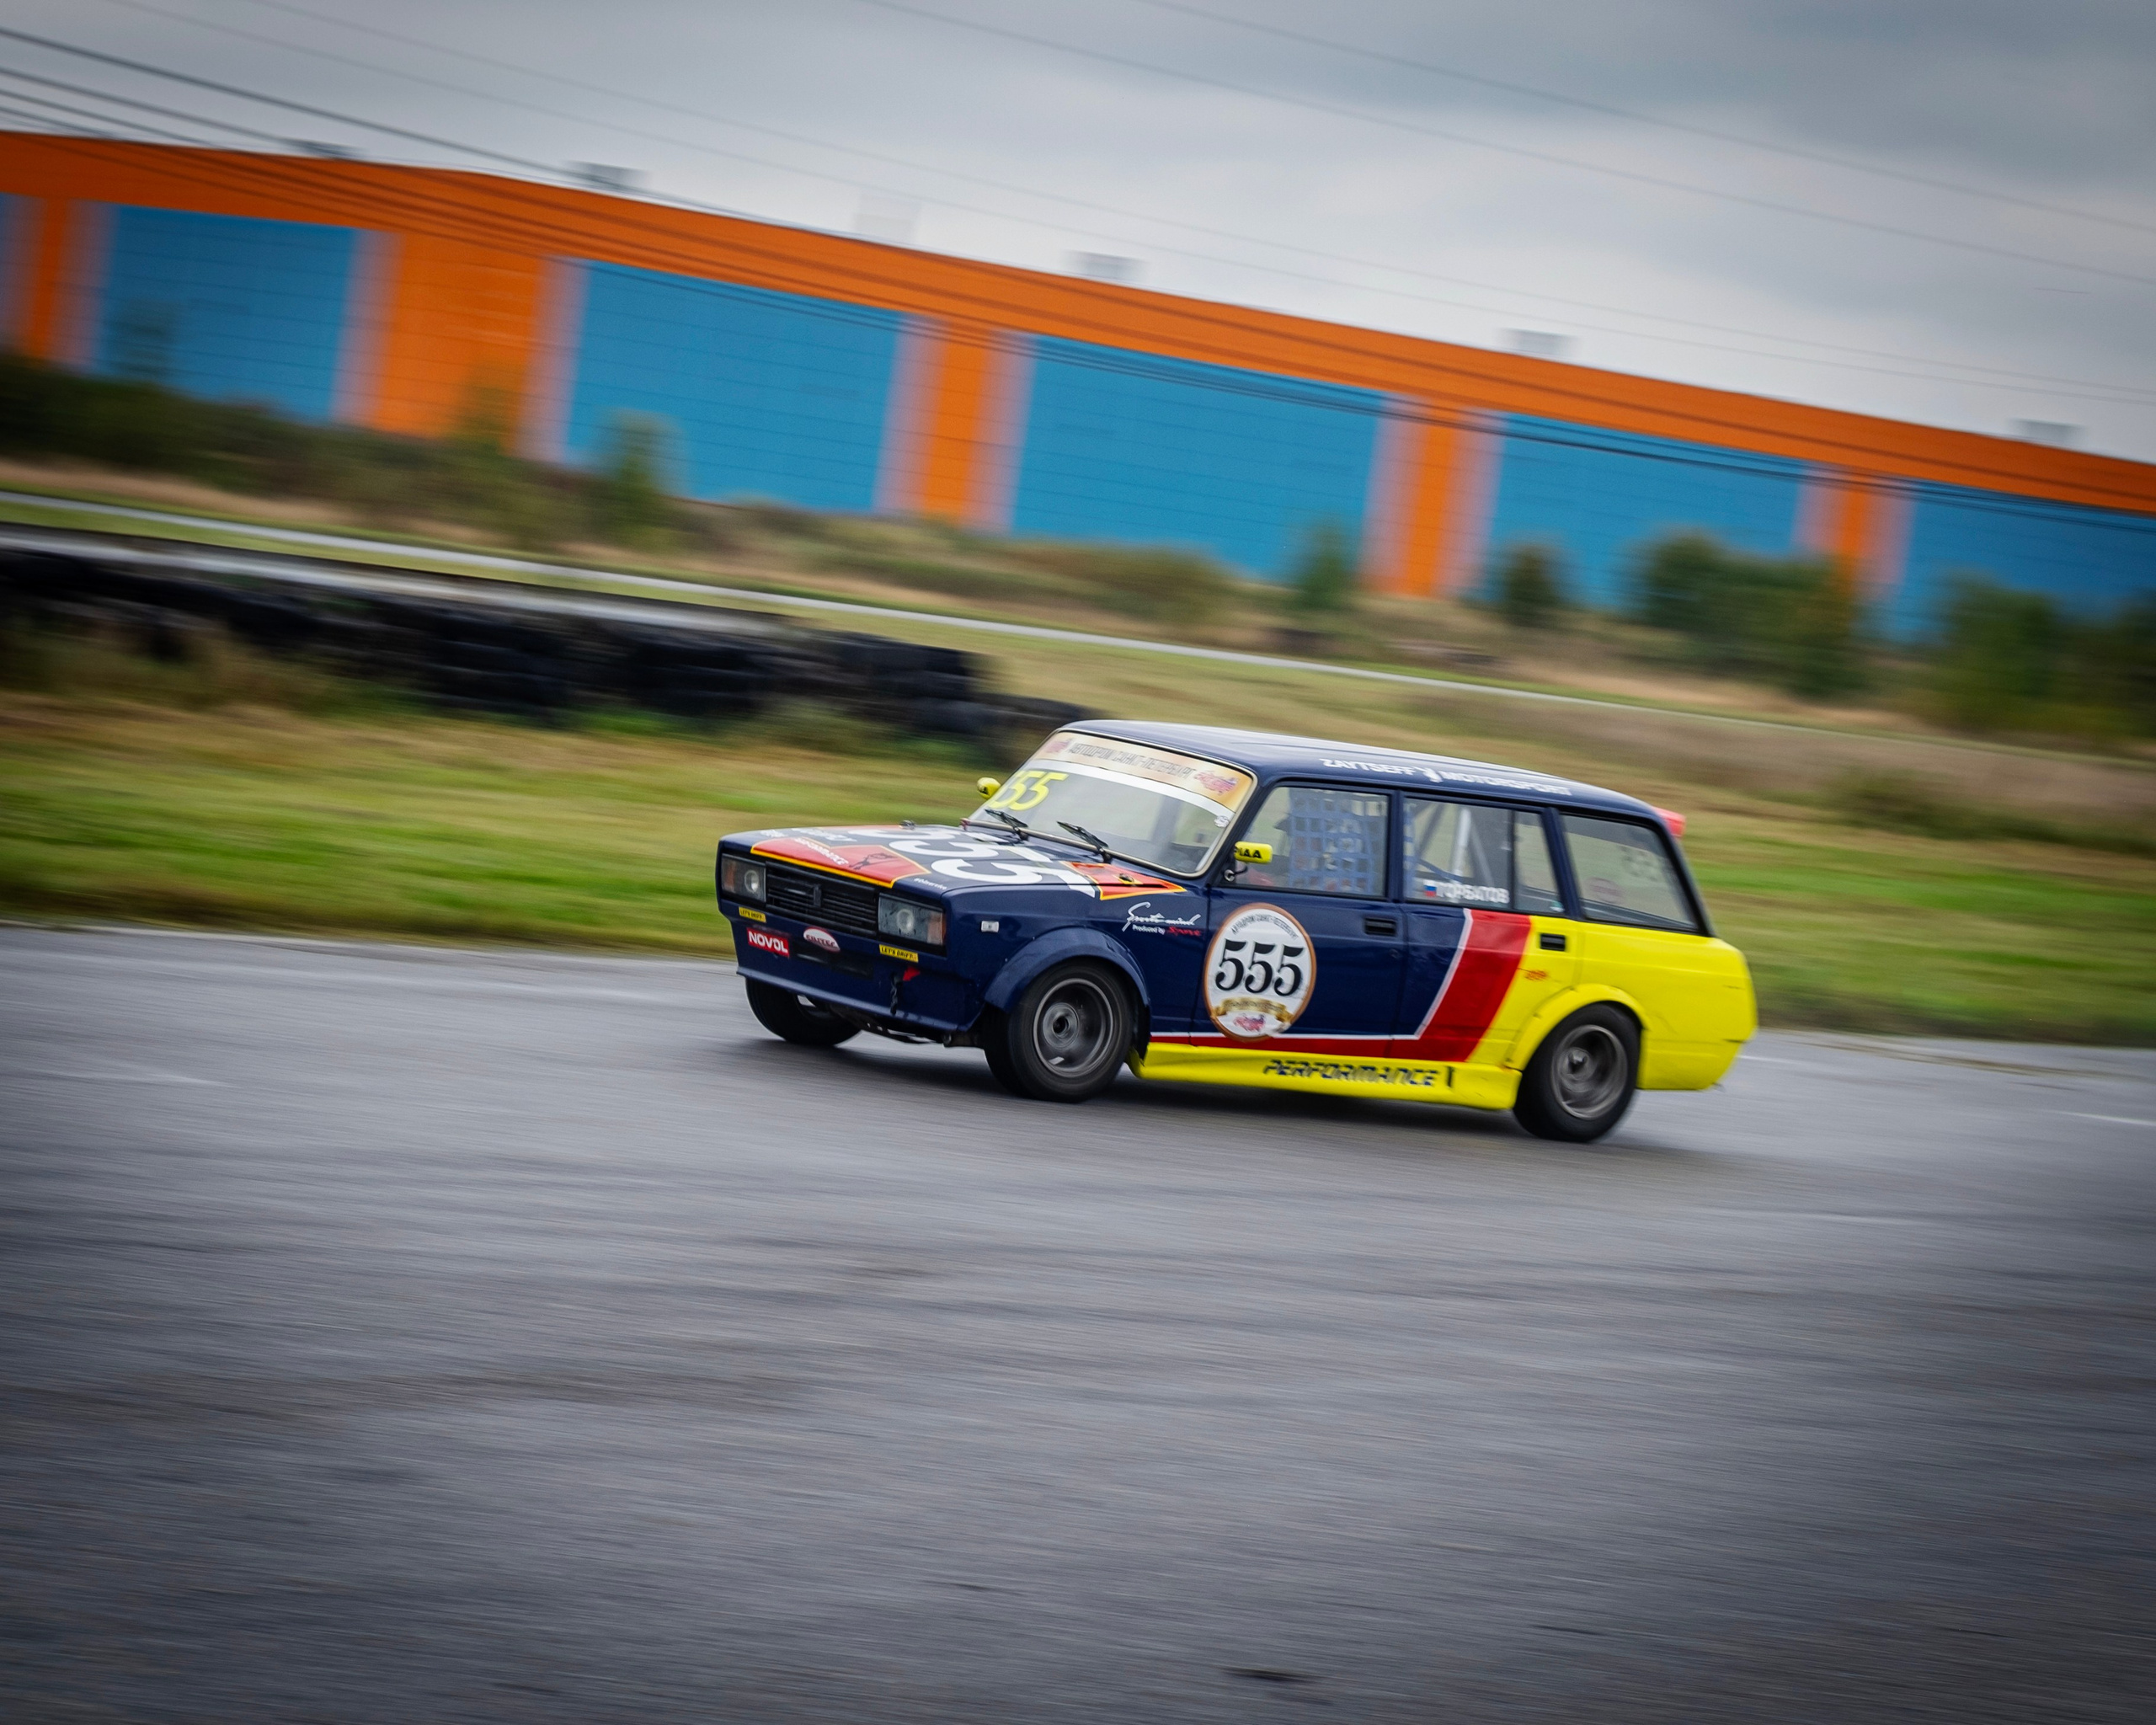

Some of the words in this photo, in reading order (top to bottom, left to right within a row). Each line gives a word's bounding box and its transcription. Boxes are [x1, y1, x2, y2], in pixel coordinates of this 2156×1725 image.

[748, 930, 789, 953] NOVOL
[1215, 938, 1305, 996] 555
[1262, 1059, 1439, 1087] PERFORMANCE
